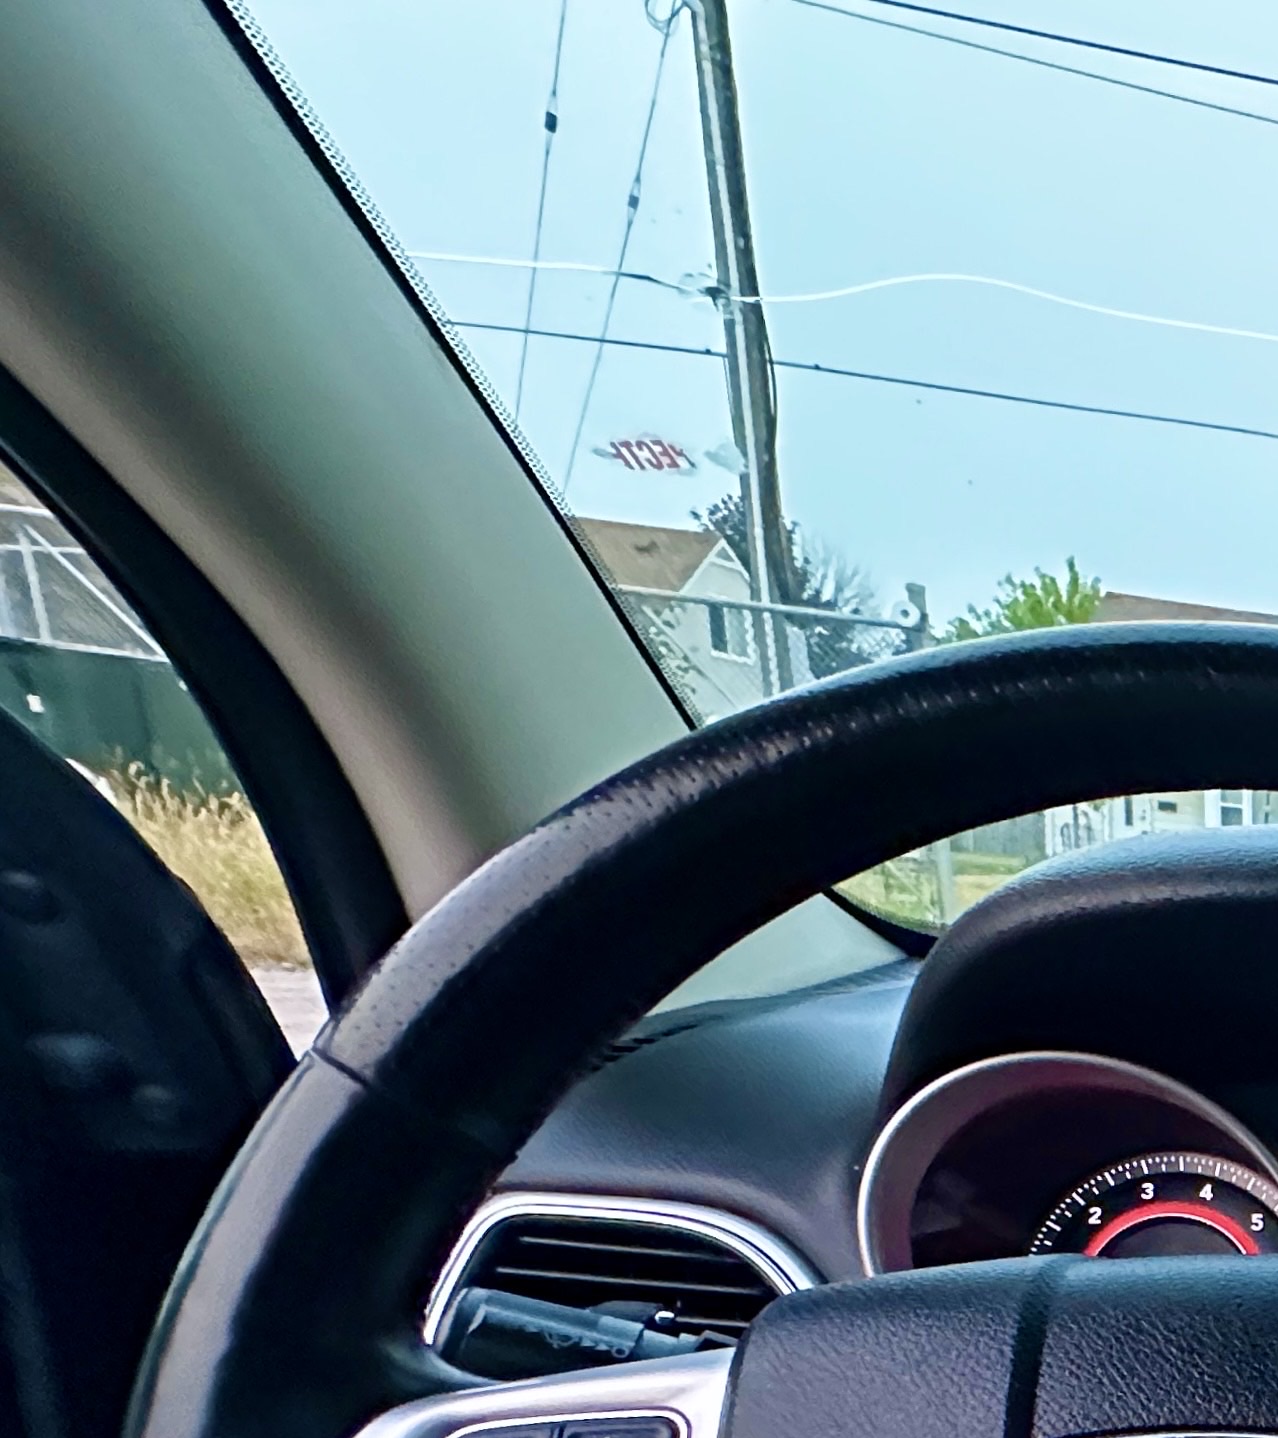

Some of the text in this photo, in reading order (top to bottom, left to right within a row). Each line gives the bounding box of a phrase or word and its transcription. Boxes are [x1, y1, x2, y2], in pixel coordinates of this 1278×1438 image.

[1088, 1183, 1264, 1231] 2 3 4 5
